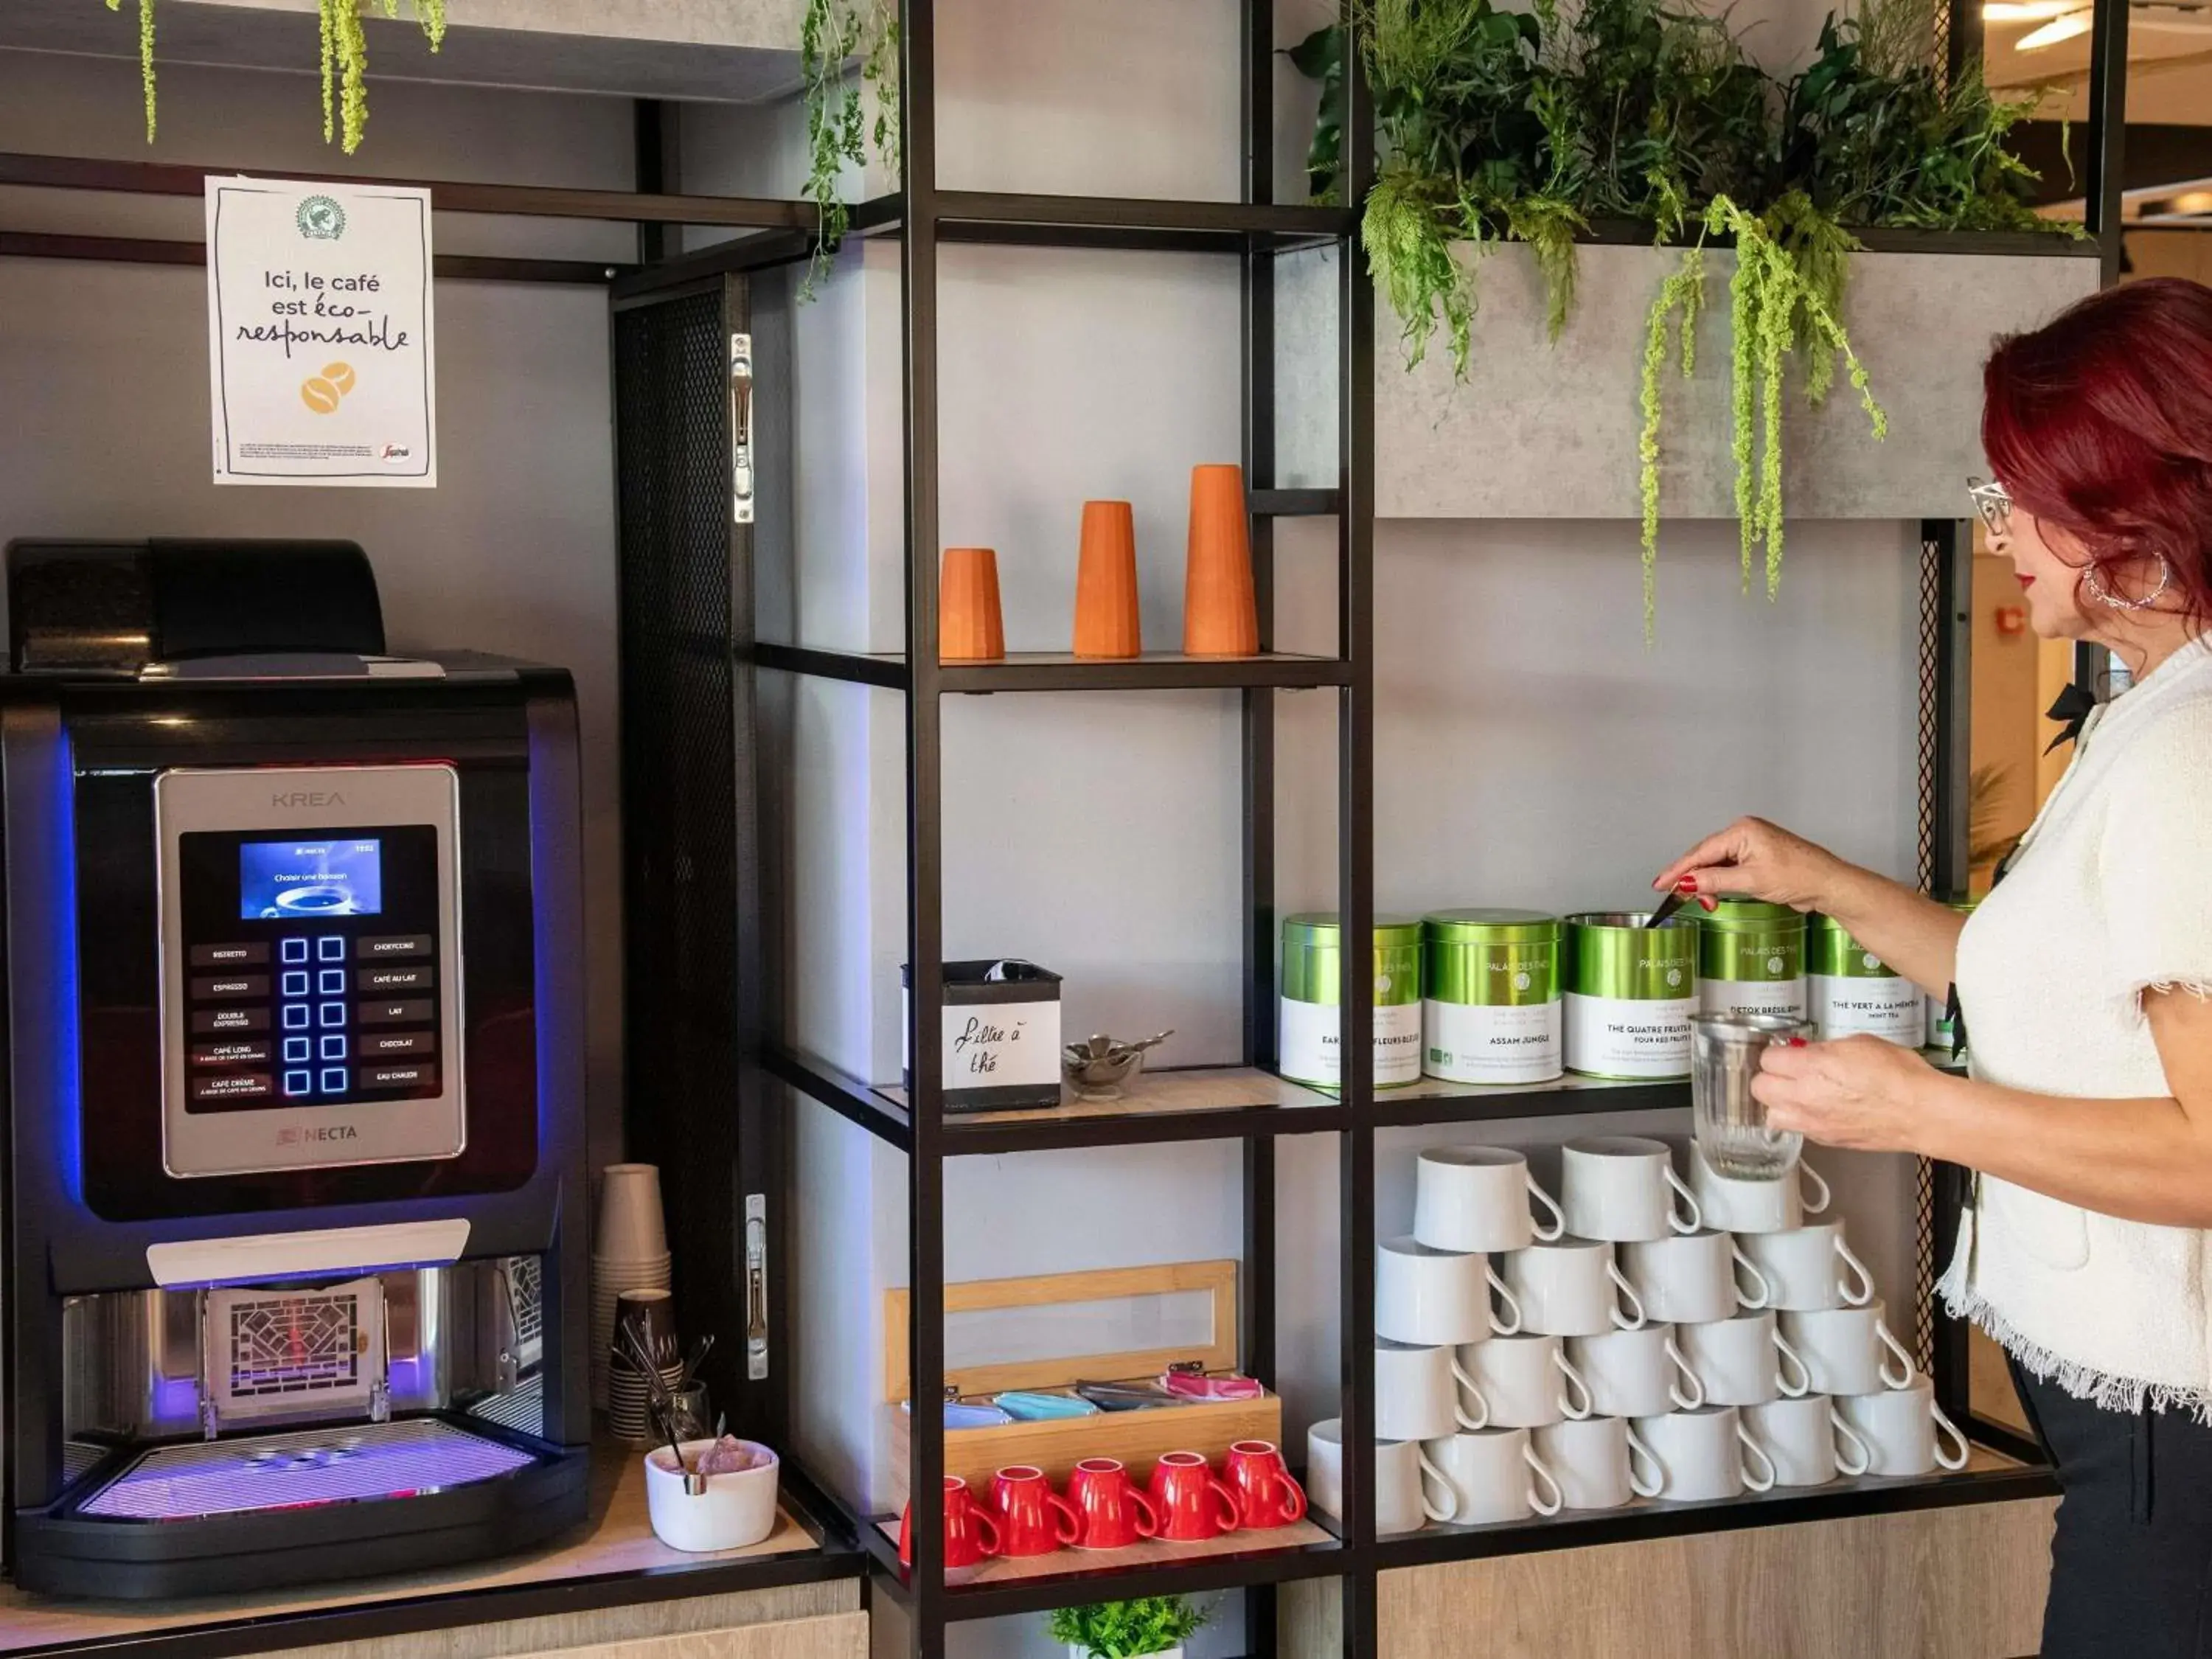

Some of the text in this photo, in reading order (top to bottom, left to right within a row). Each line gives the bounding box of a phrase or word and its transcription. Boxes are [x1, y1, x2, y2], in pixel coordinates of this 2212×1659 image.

[265, 271, 380, 292] Ici, le café
[271, 293, 372, 317] est éco-
[236, 315, 410, 358] responsable
[272, 792, 346, 807] KREA
[274, 874, 300, 883] Choisir
[389, 1007, 403, 1015] LAIT
[380, 1039, 413, 1048] CHOCOLAT
[1489, 1037, 1520, 1045] ASSAM
[970, 1051, 998, 1074] thé
[305, 1125, 358, 1142] NECTA
